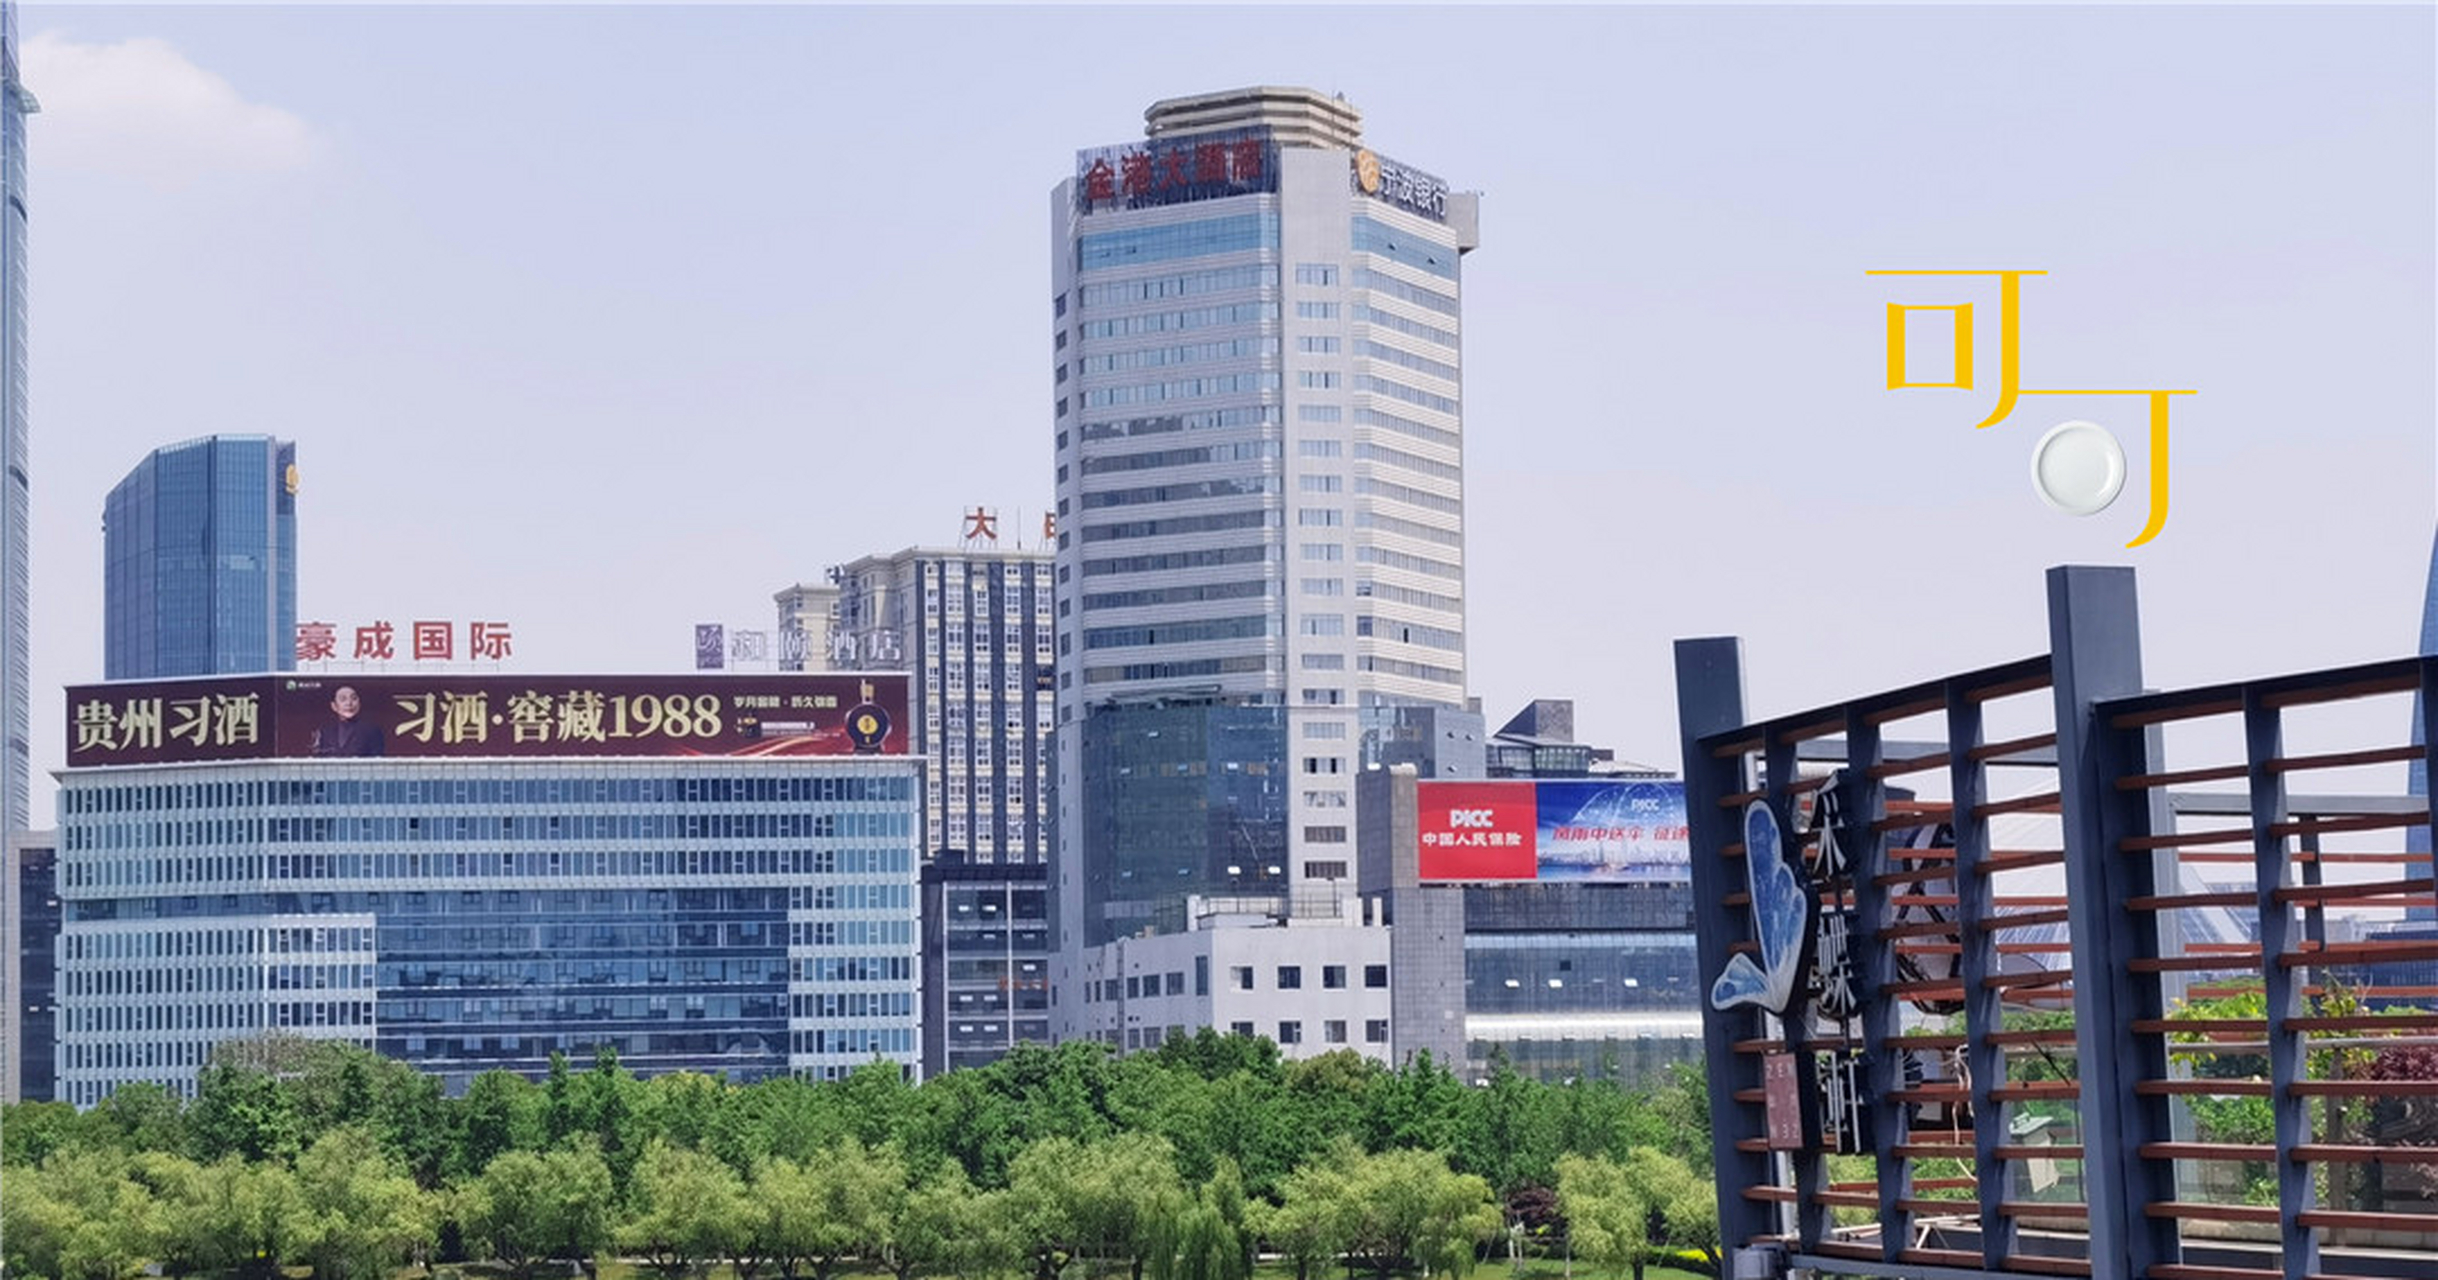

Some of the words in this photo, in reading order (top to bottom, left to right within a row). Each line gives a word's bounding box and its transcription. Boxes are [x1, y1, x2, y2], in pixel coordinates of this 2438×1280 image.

[1381, 165, 1448, 217] 宁波银行
[295, 620, 513, 661] 豪成国际
[73, 692, 260, 753] 贵州习酒
[1450, 809, 1494, 828] PICC
[1631, 798, 1660, 812] PICC
[1422, 831, 1522, 847] 中国人民保险
